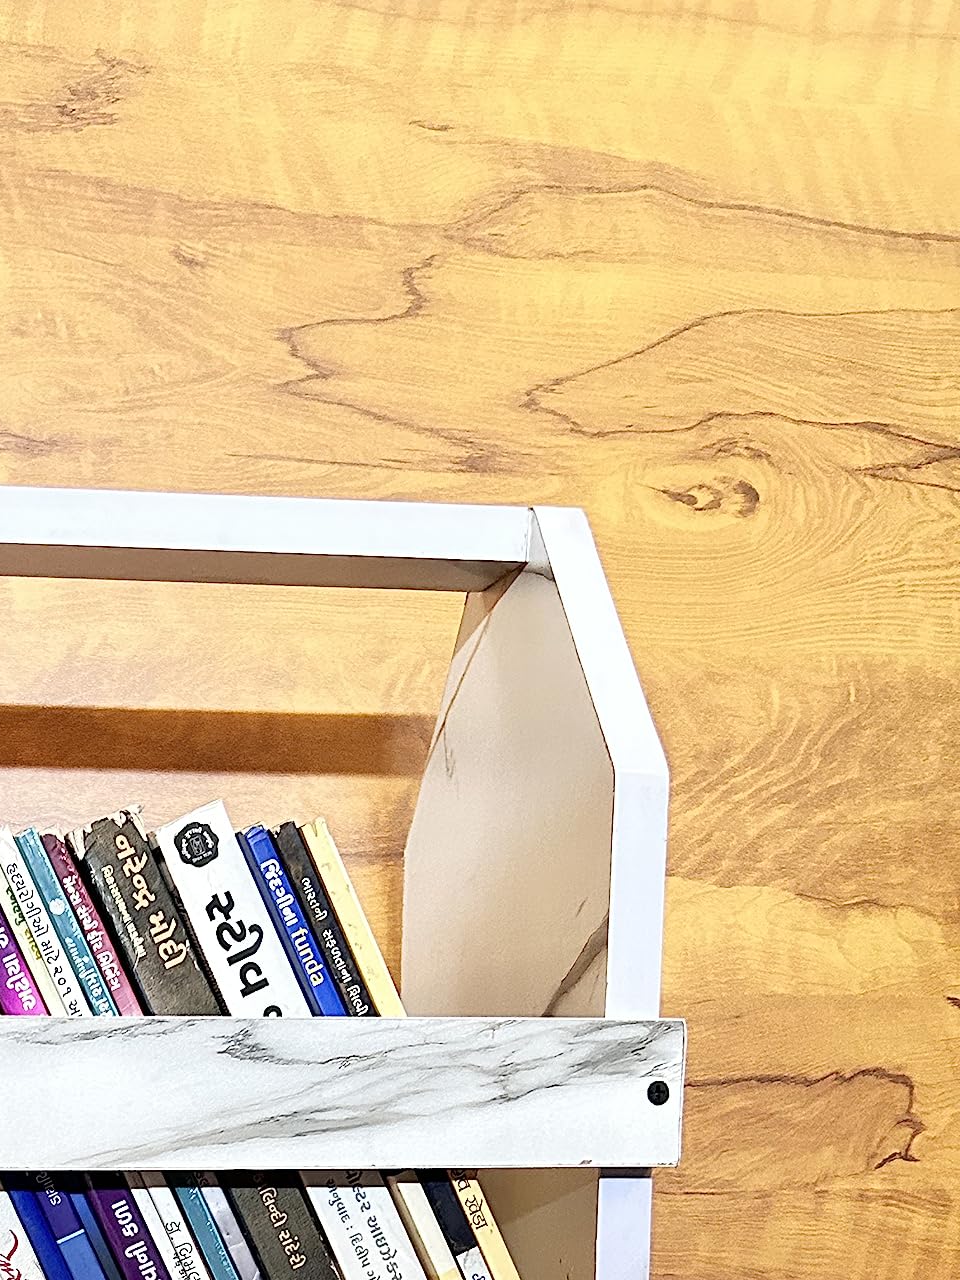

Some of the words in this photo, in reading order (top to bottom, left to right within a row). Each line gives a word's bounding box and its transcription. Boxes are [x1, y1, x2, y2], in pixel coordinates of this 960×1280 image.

[114, 834, 155, 910] નરેન્દ્ર
[148, 909, 185, 970] મોદી
[300, 876, 328, 921] ભારતની
[324, 928, 353, 984] સફળતાના
[40, 938, 58, 964] માટે
[50, 962, 73, 997] ૨૦૧
[209, 890, 269, 997] સ્ટીવ
[289, 927, 325, 987] funda
[110, 1198, 138, 1237] કળા
[278, 1227, 306, 1270] રાંદેરી
[349, 1232, 370, 1268] દિલીપ
